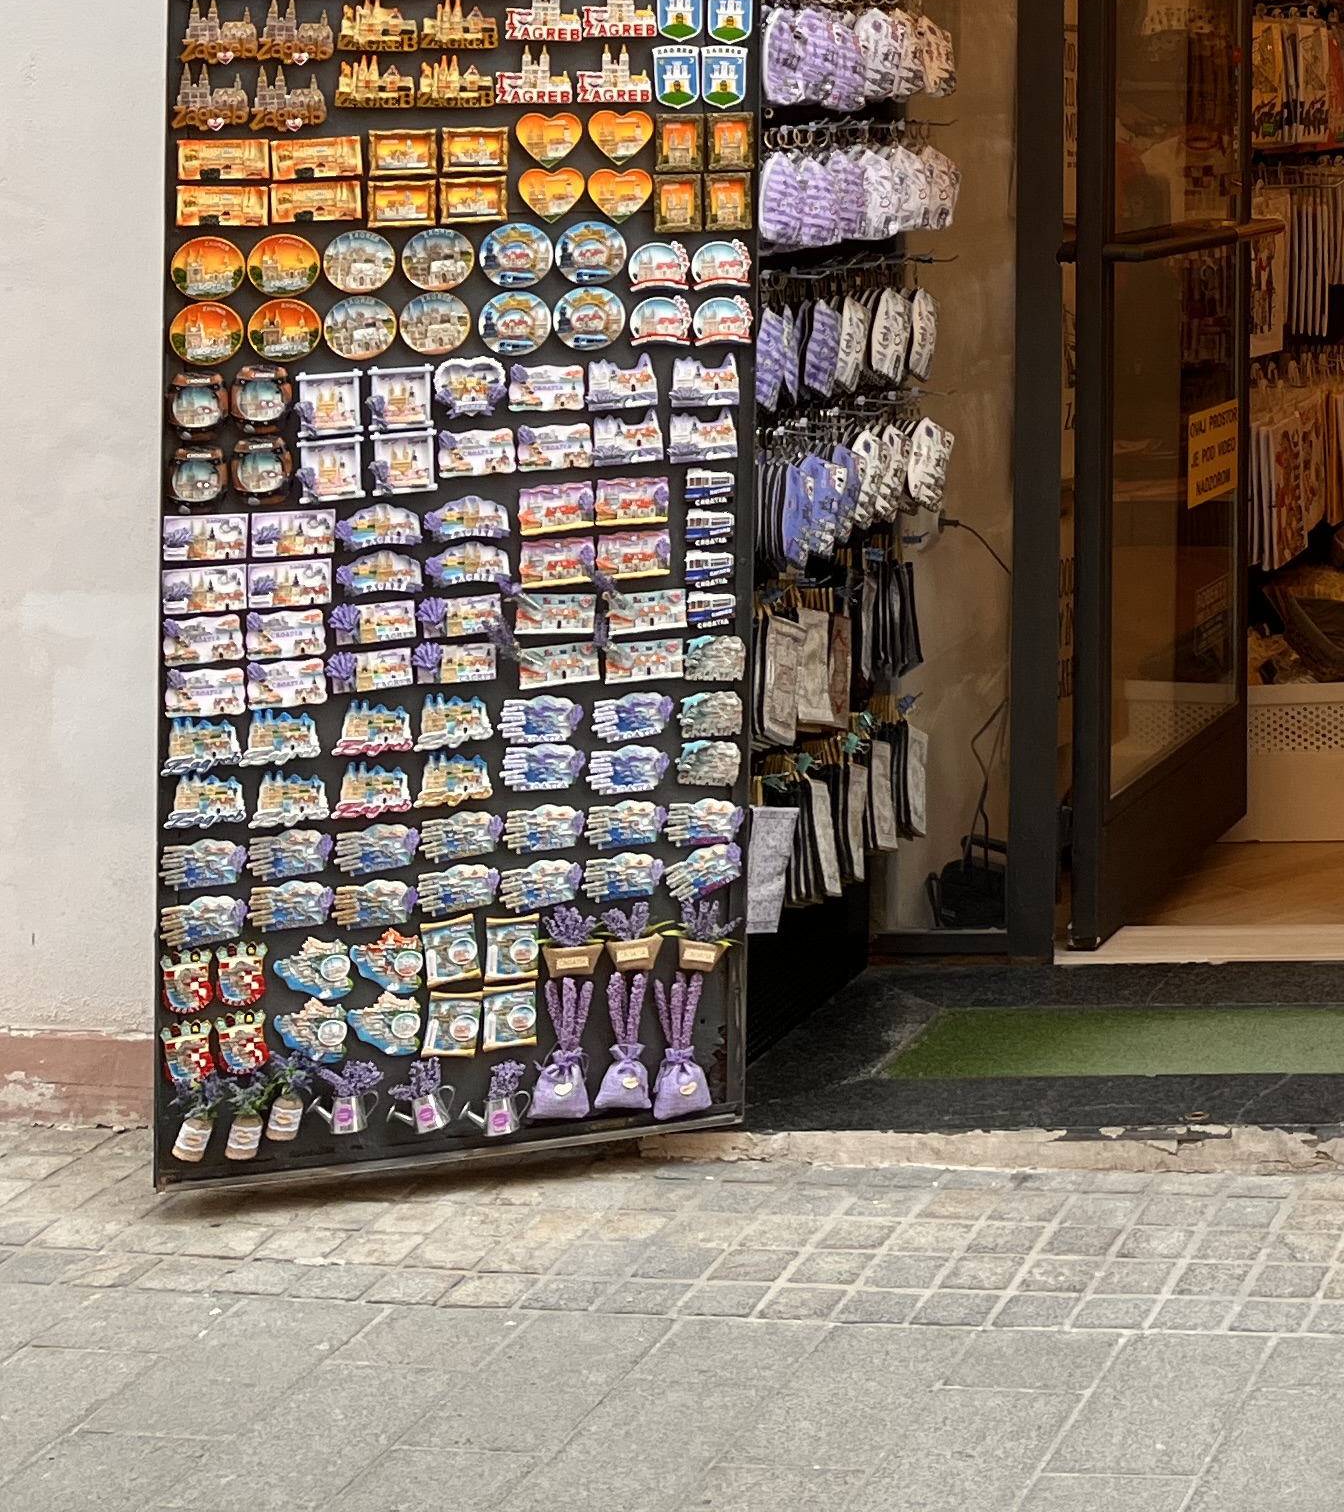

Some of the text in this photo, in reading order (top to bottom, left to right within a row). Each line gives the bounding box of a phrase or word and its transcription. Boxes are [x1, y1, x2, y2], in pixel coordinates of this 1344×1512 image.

[508, 28, 580, 41] ZAGREB
[583, 24, 656, 37] ZAGREB
[499, 90, 571, 103] ZAGREB
[579, 89, 650, 103] ZAGREB
